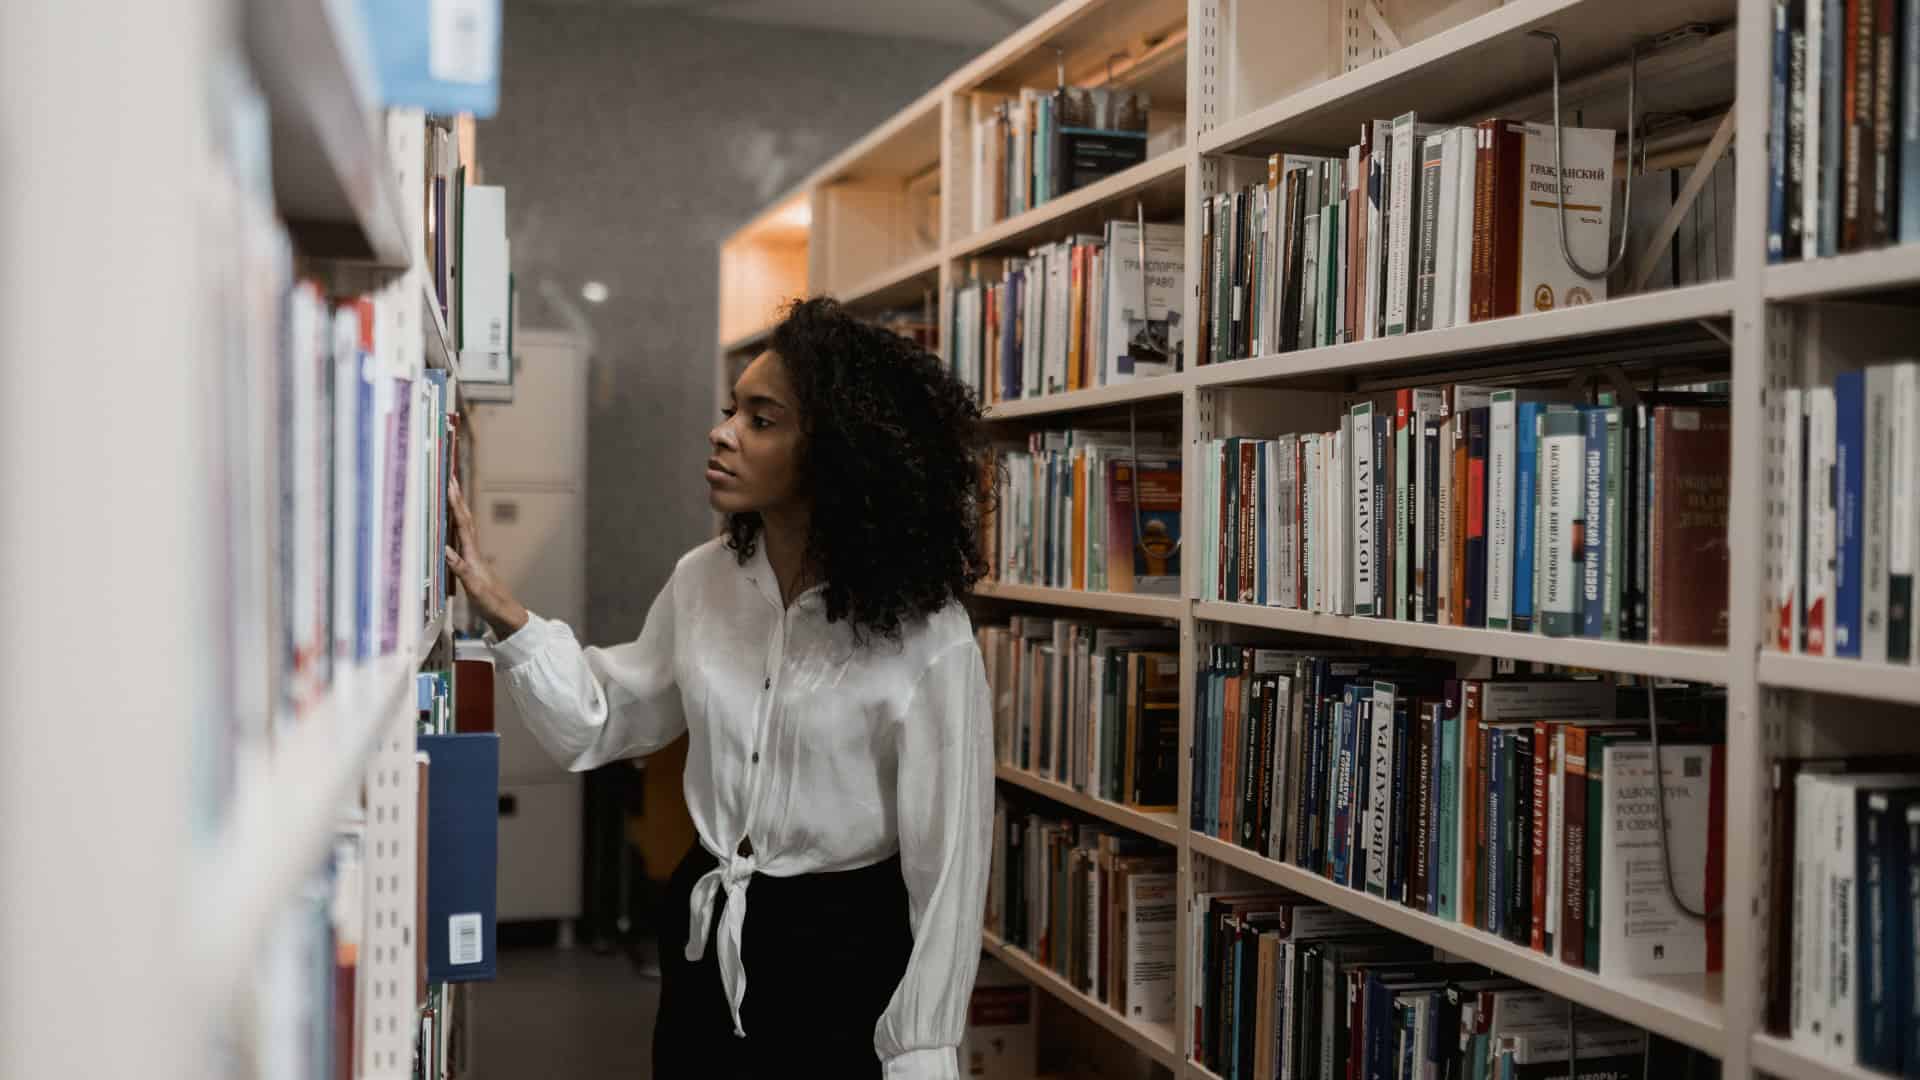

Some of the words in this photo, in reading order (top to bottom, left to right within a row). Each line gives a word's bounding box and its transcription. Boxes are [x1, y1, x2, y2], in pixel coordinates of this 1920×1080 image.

[1530, 163, 1605, 180] ГРАЖАНСКИЙ
[1550, 444, 1560, 507] НАСТОЛЬНАЯ
[1586, 450, 1600, 547] ПРОКУРОРСКИЙ
[1359, 456, 1369, 583] НОТАРИАТ
[1550, 511, 1559, 542] КНИГА
[1549, 547, 1558, 602] ПРОКУРОРА
[1584, 552, 1598, 601] НАДЗОР
[1372, 723, 1388, 881] АДВОКАТУРА
[1534, 757, 1543, 856] АДВОКАТУРА
[1617, 787, 1694, 799] АДВОКТУРА
